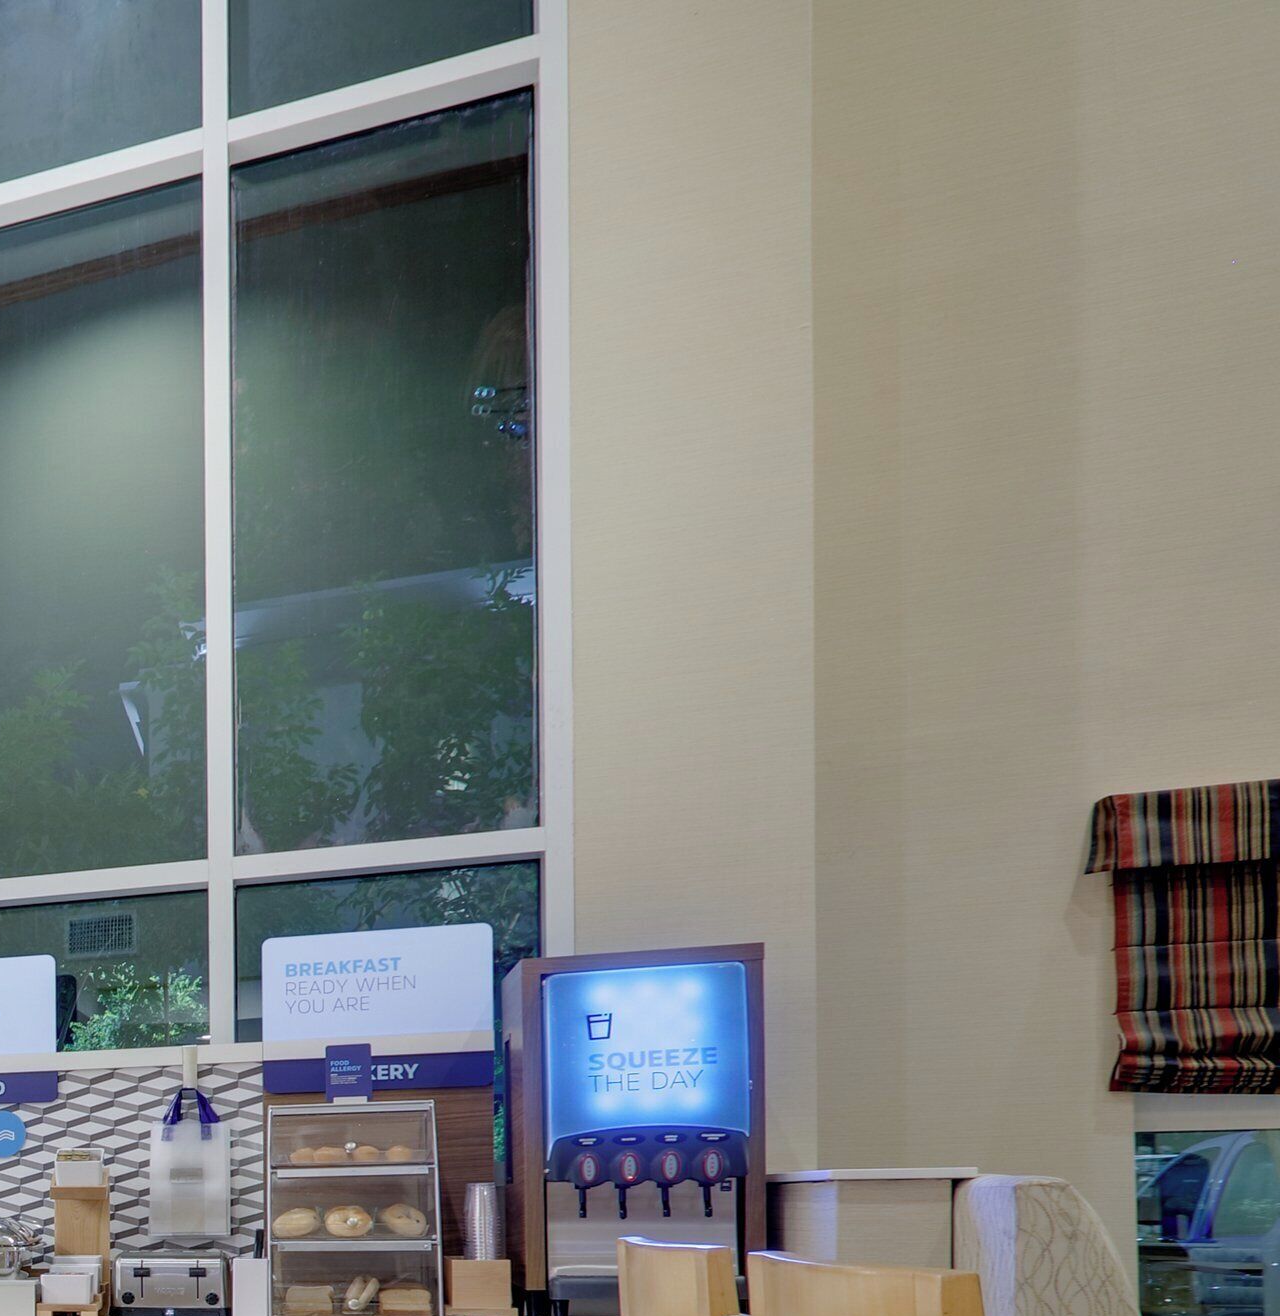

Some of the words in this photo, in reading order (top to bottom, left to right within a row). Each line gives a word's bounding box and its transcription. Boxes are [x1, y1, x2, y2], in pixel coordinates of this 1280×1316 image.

[285, 956, 401, 977] BREAKFAST
[285, 979, 348, 996] READY
[355, 975, 416, 992] WHEN
[285, 999, 325, 1014] YOU
[332, 996, 370, 1012] ARE
[588, 1047, 717, 1071] SQUEEZE
[371, 1063, 419, 1081] KERY
[588, 1072, 640, 1092] THE
[652, 1069, 704, 1090] DAY
